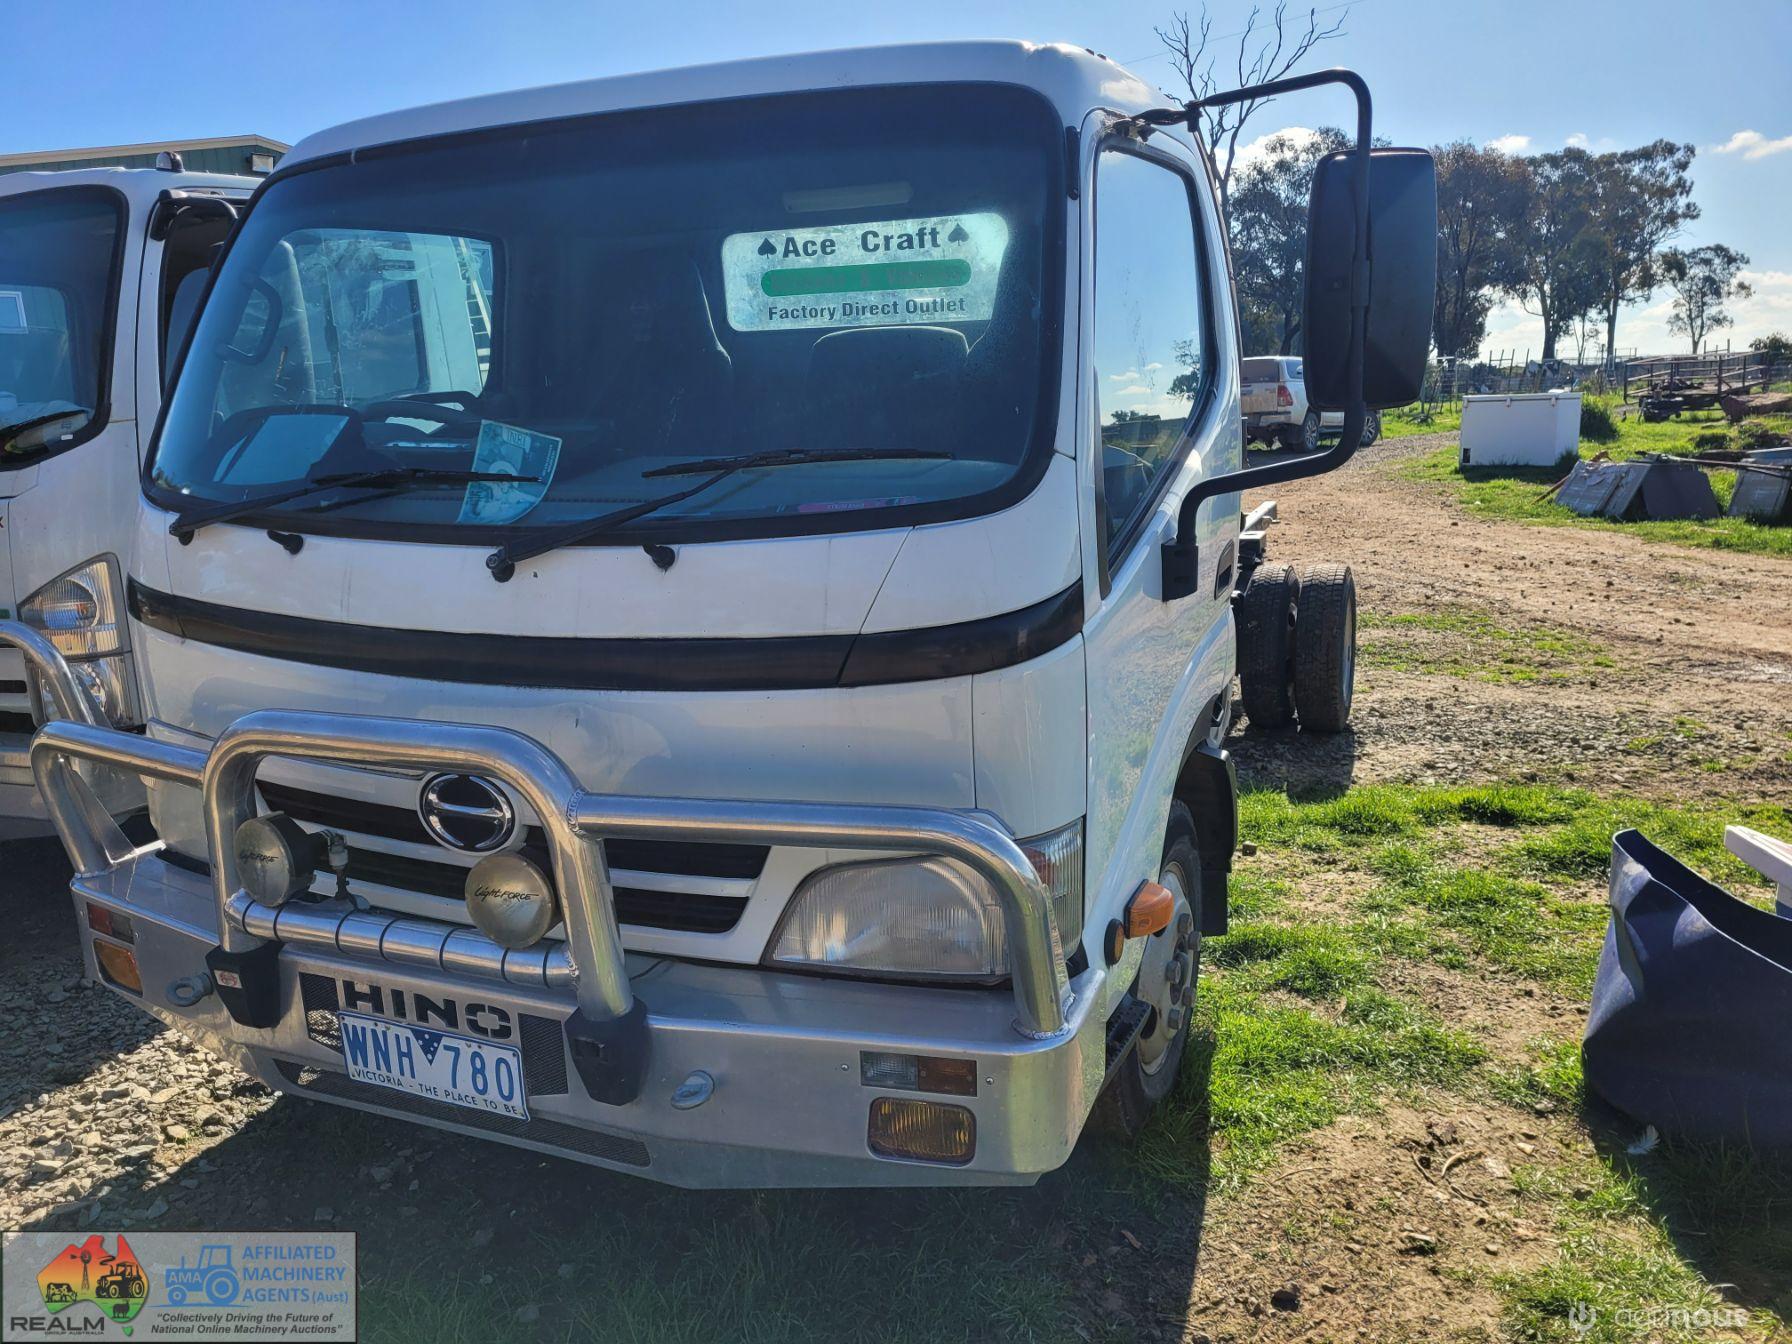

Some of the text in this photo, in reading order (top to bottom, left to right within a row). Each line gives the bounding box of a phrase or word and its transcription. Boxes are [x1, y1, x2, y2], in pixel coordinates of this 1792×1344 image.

[782, 226, 941, 258] Ace Craft
[768, 297, 967, 321] Factory Direct Outlet
[343, 980, 512, 1040] HINO
[343, 1022, 514, 1102] WNH 780
[354, 1068, 404, 1087] VICTORIA
[418, 1083, 439, 1097] THE
[445, 1089, 478, 1106] PLACE
[484, 1098, 498, 1110] TO
[505, 1105, 518, 1115] BE
